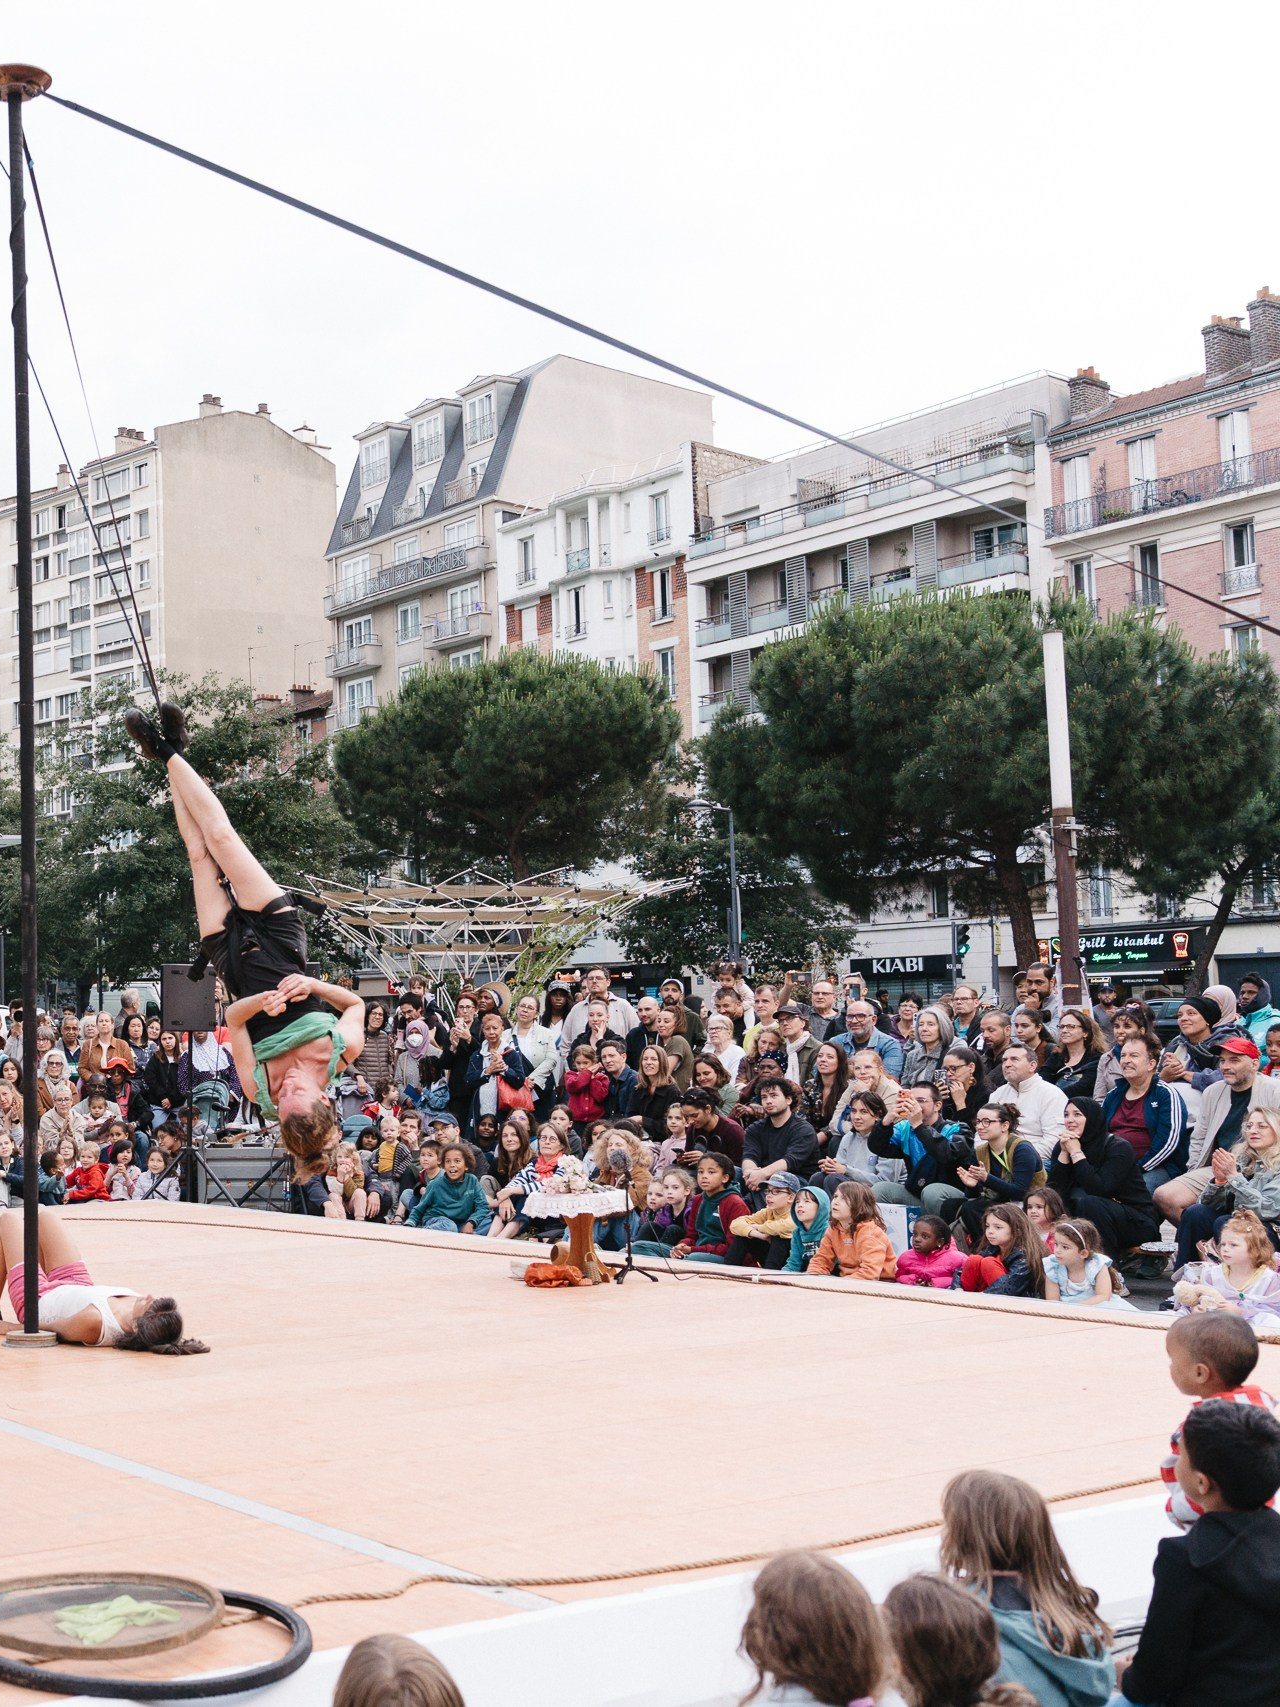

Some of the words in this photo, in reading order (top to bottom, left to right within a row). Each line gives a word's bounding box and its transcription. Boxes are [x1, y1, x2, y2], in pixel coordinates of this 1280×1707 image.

[1078, 936, 1106, 952] Grill
[1113, 933, 1164, 948] istanbul
[872, 957, 924, 974] KIABI
